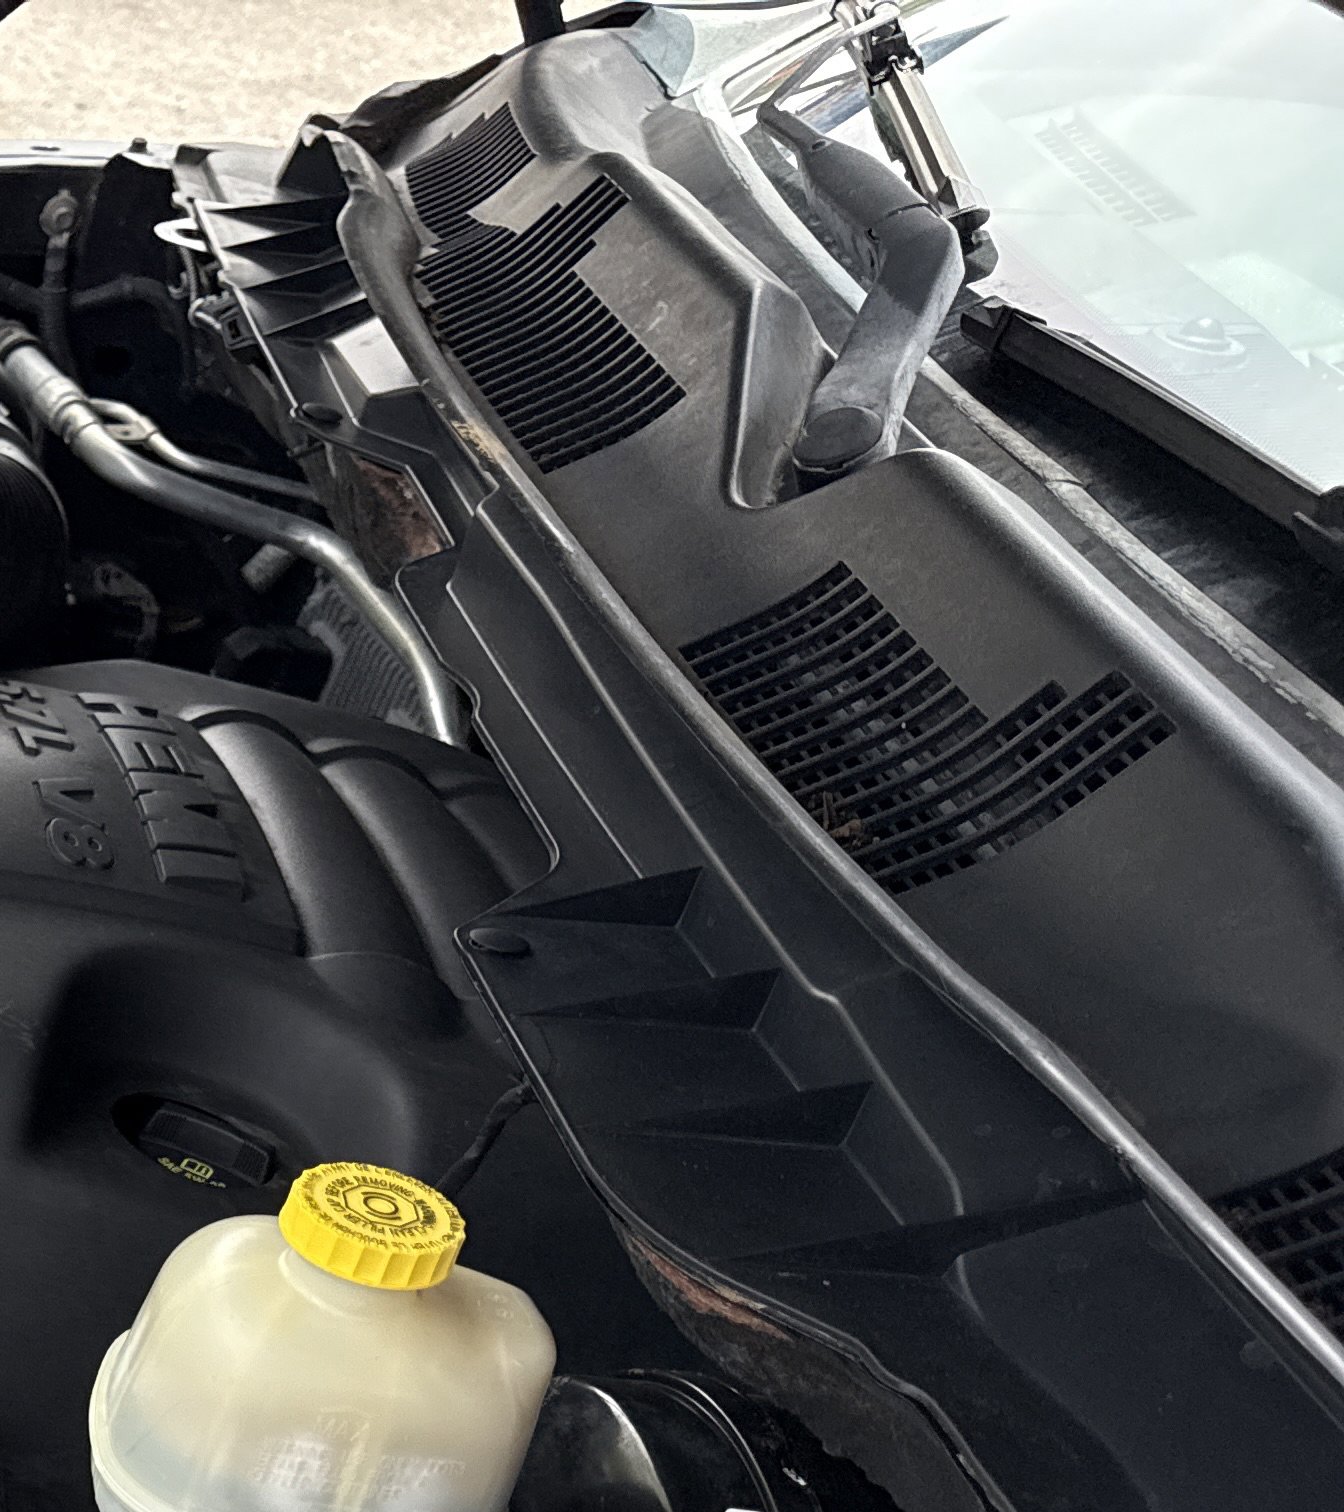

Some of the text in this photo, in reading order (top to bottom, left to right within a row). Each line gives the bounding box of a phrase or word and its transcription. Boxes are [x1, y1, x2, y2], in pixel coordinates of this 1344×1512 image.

[31, 776, 116, 870] V8
[74, 691, 246, 892] HEMI
[353, 1175, 415, 1198] REMOVING
